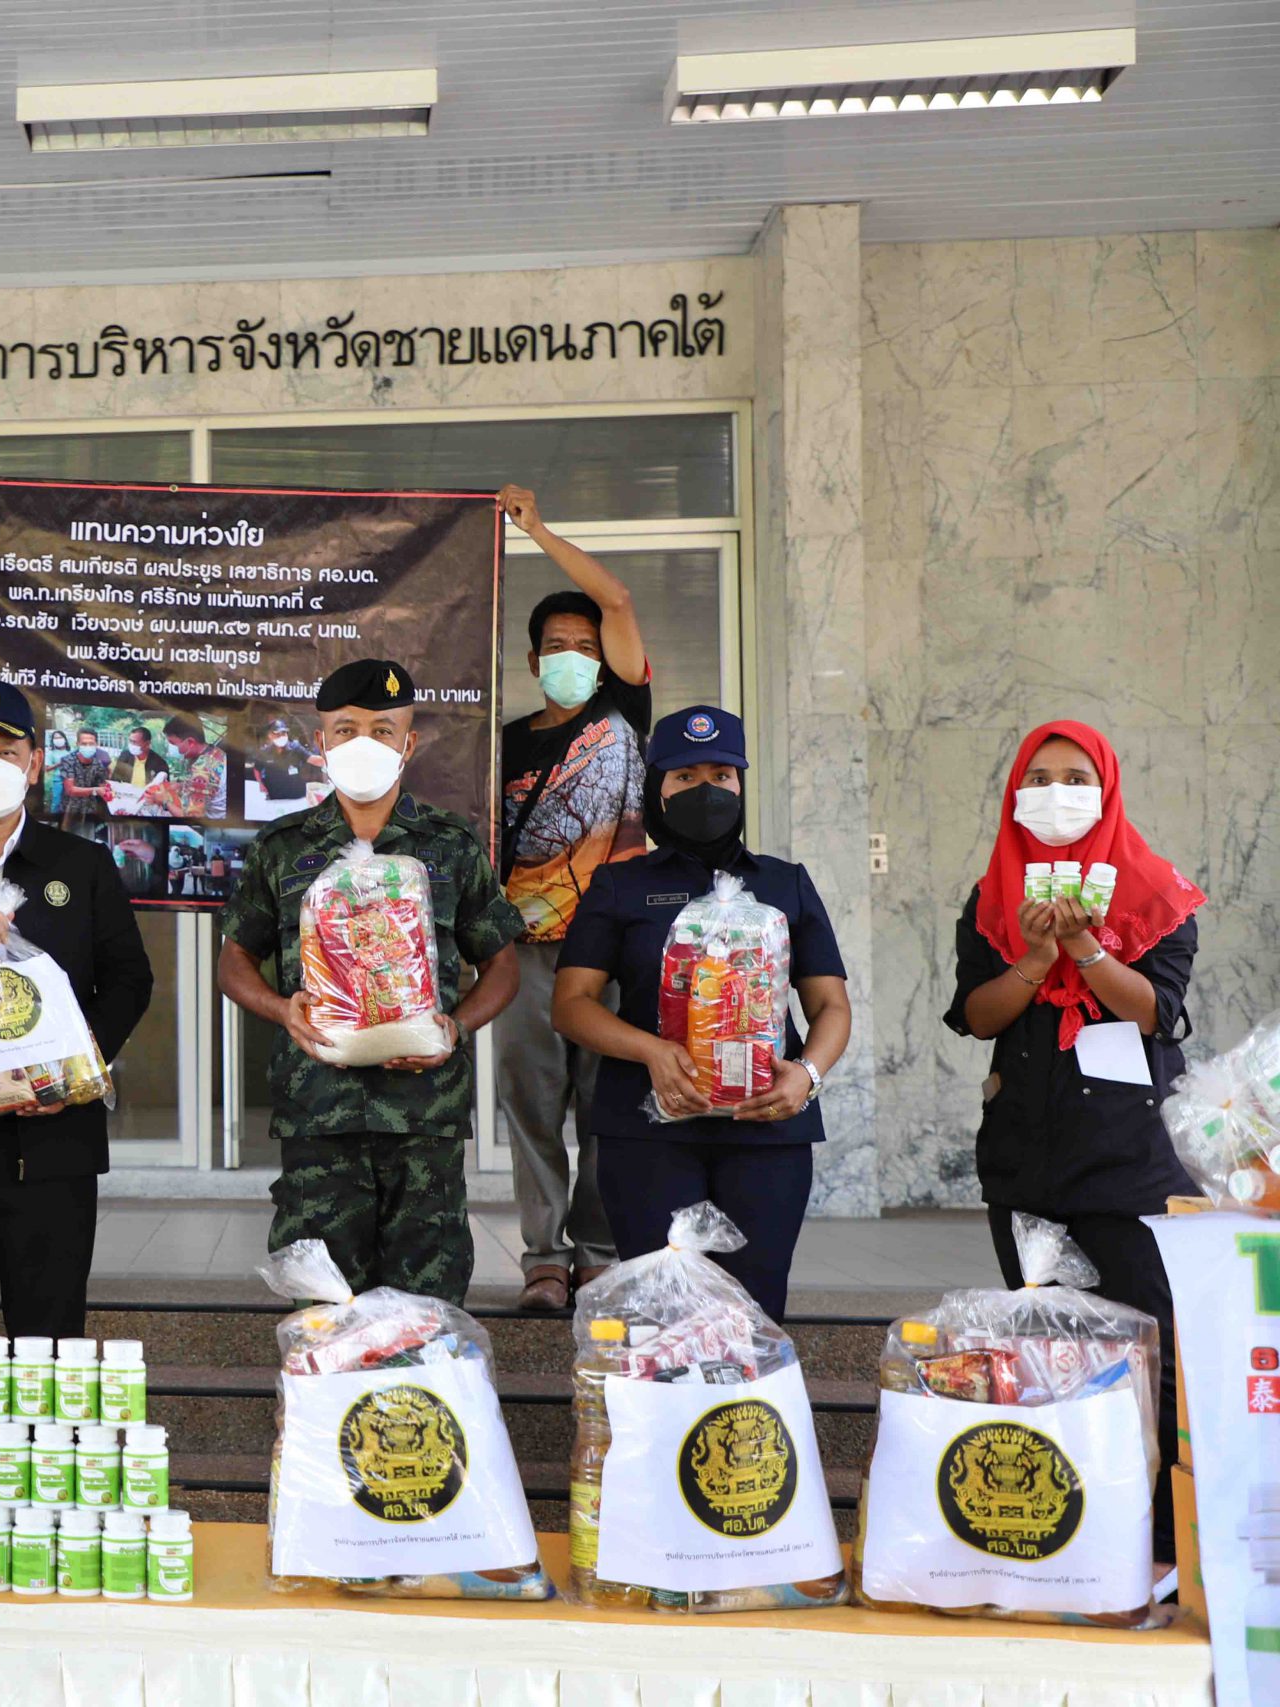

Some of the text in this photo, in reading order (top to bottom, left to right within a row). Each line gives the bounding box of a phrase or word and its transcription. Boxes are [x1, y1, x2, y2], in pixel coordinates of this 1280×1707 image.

[70, 512, 264, 547] แทนความห่วงใย
[59, 556, 138, 576] สมเกียรติ
[143, 557, 223, 581] ผลประยูร
[226, 563, 312, 580] เลขาธิการ
[318, 567, 380, 583] ศอ.บต.
[8, 584, 324, 609] พล.ท.เกรียงไกร ศรีรักษ์ แม่ทัพภาคที่ ๔
[71, 611, 145, 633] เวียงวงษ์
[149, 618, 251, 636] ผบ.นพค.๔๒
[256, 622, 313, 637] สนภ.๔
[317, 621, 361, 639] นทพ.
[66, 641, 164, 662] นพ.ชัยวัฒน์
[40, 672, 135, 694] สำนักข่าวอิศรา
[138, 671, 212, 696] ข่าวสดยะลา
[440, 688, 481, 703] บาเหม
